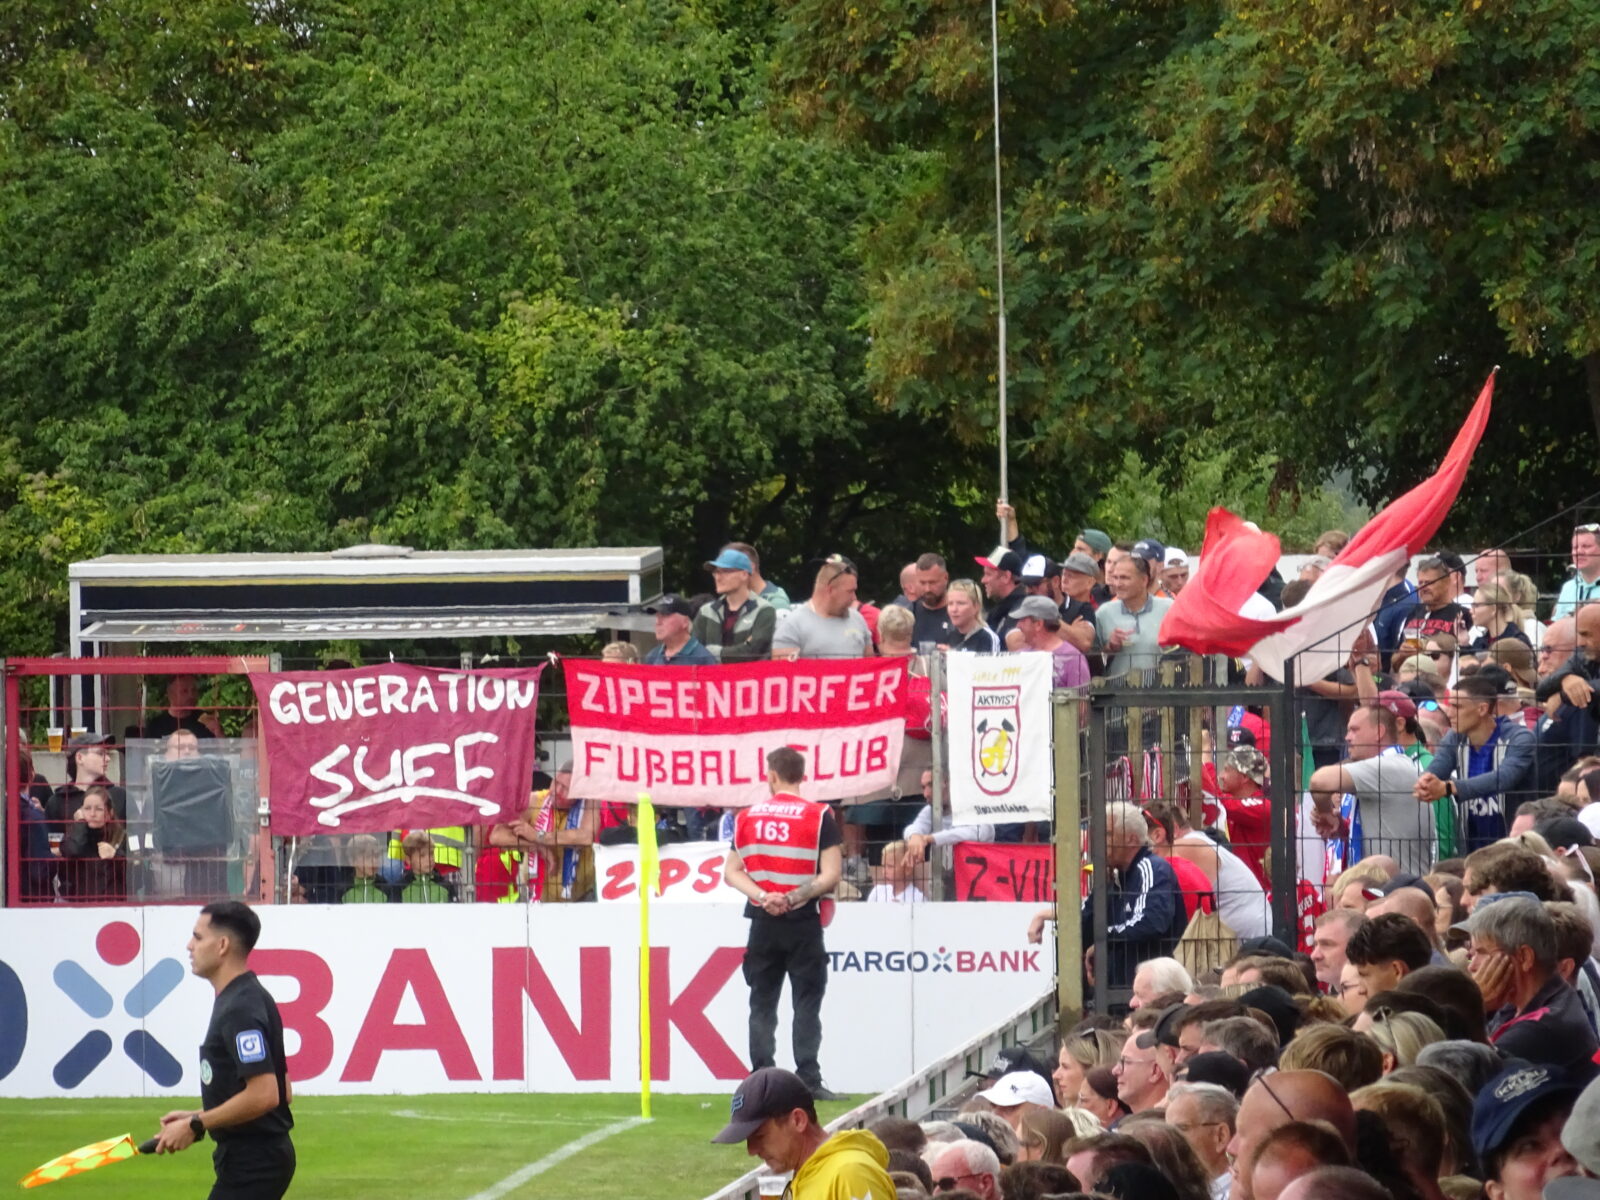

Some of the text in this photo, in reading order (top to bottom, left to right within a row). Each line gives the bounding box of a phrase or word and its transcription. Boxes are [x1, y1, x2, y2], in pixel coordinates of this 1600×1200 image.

[269, 674, 535, 725] GENERATION
[576, 667, 903, 720] ZIPSENDORFER
[309, 731, 499, 808] SUFF
[585, 735, 888, 788] FUßBALLLUB
[755, 819, 790, 842] 163
[601, 855, 725, 900] ZPS
[215, 946, 753, 1082] BANK
